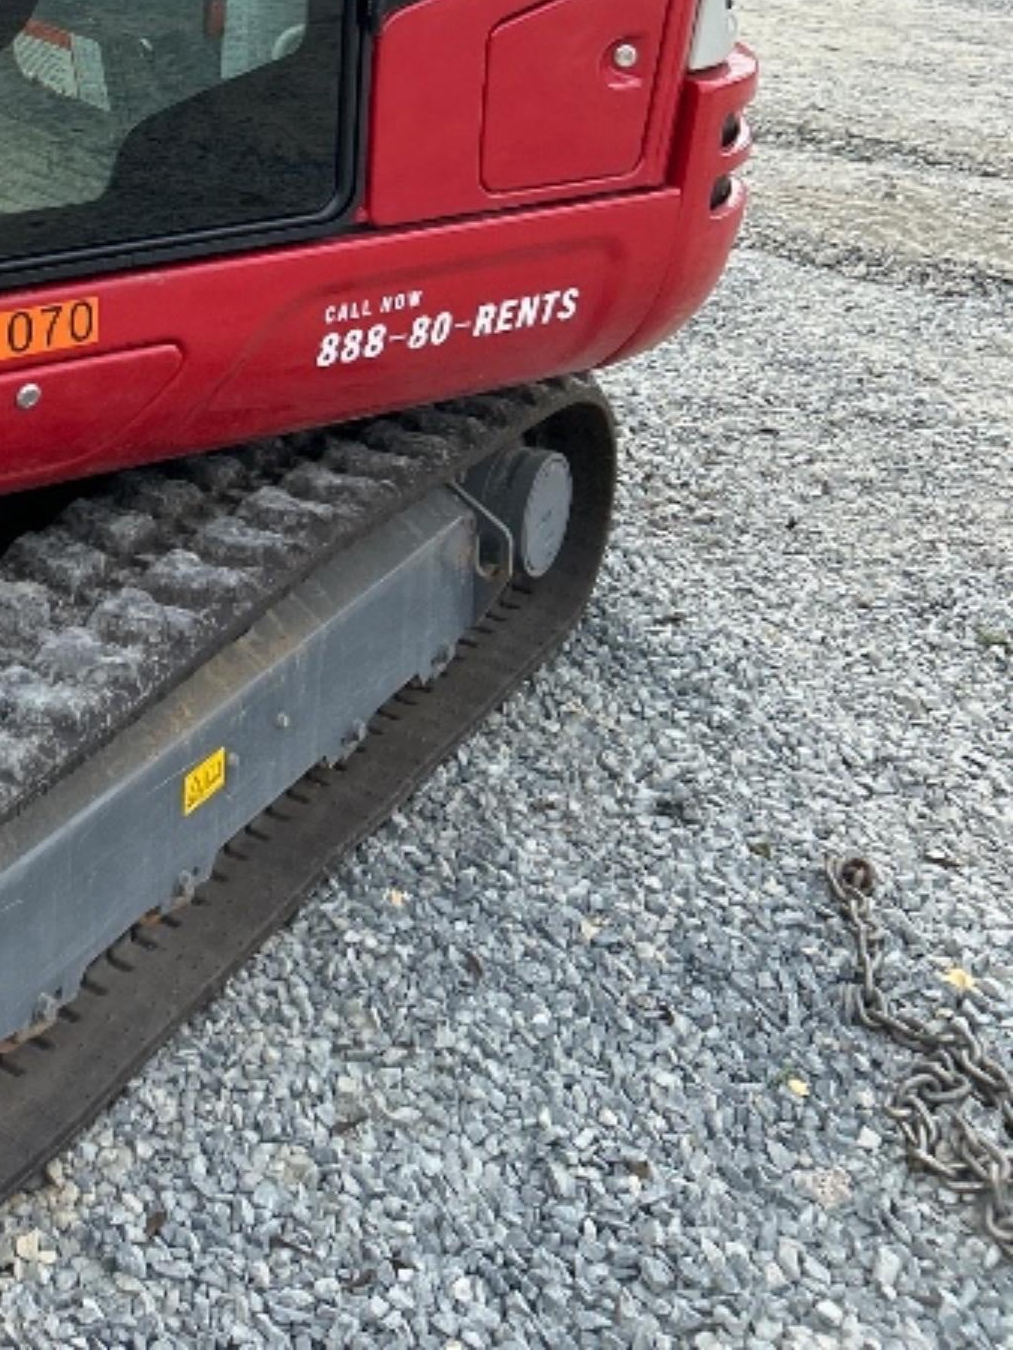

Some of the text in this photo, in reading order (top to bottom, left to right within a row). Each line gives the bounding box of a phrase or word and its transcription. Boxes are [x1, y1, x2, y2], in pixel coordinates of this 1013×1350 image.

[316, 287, 580, 368] 888-80-RENTS
[325, 290, 423, 324] CALL NOW
